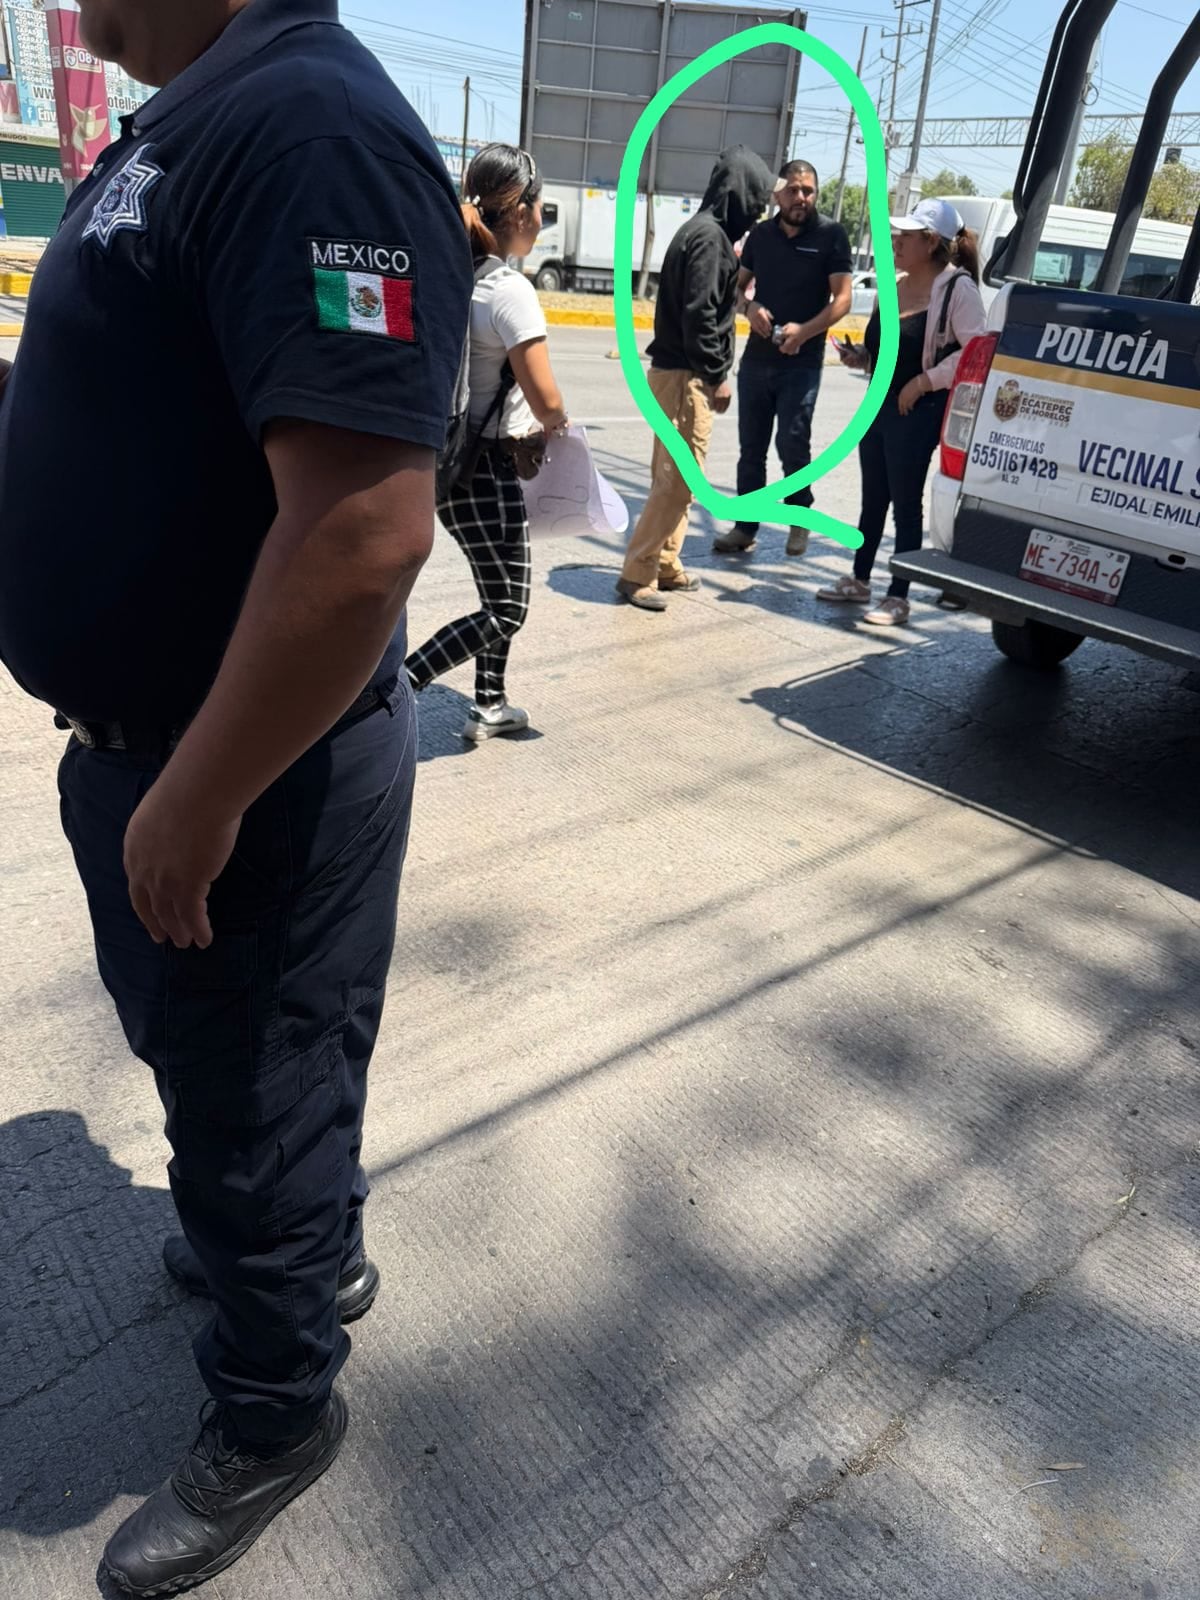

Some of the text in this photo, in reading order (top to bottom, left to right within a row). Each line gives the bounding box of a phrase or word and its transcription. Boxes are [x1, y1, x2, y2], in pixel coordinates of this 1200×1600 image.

[312, 241, 410, 273] MEXICO
[1035, 322, 1169, 379] POLICÍA
[1020, 406, 1029, 414] DE
[1032, 409, 1070, 423] MORELOS
[1022, 398, 1073, 415] ECATEPEC
[989, 431, 1045, 455] EMERGENCIAS
[972, 443, 1058, 480] 5551167428
[1079, 440, 1184, 495] VECINAL
[1090, 487, 1148, 515] EJIDAL
[1025, 542, 1122, 589] ME-734A-6
